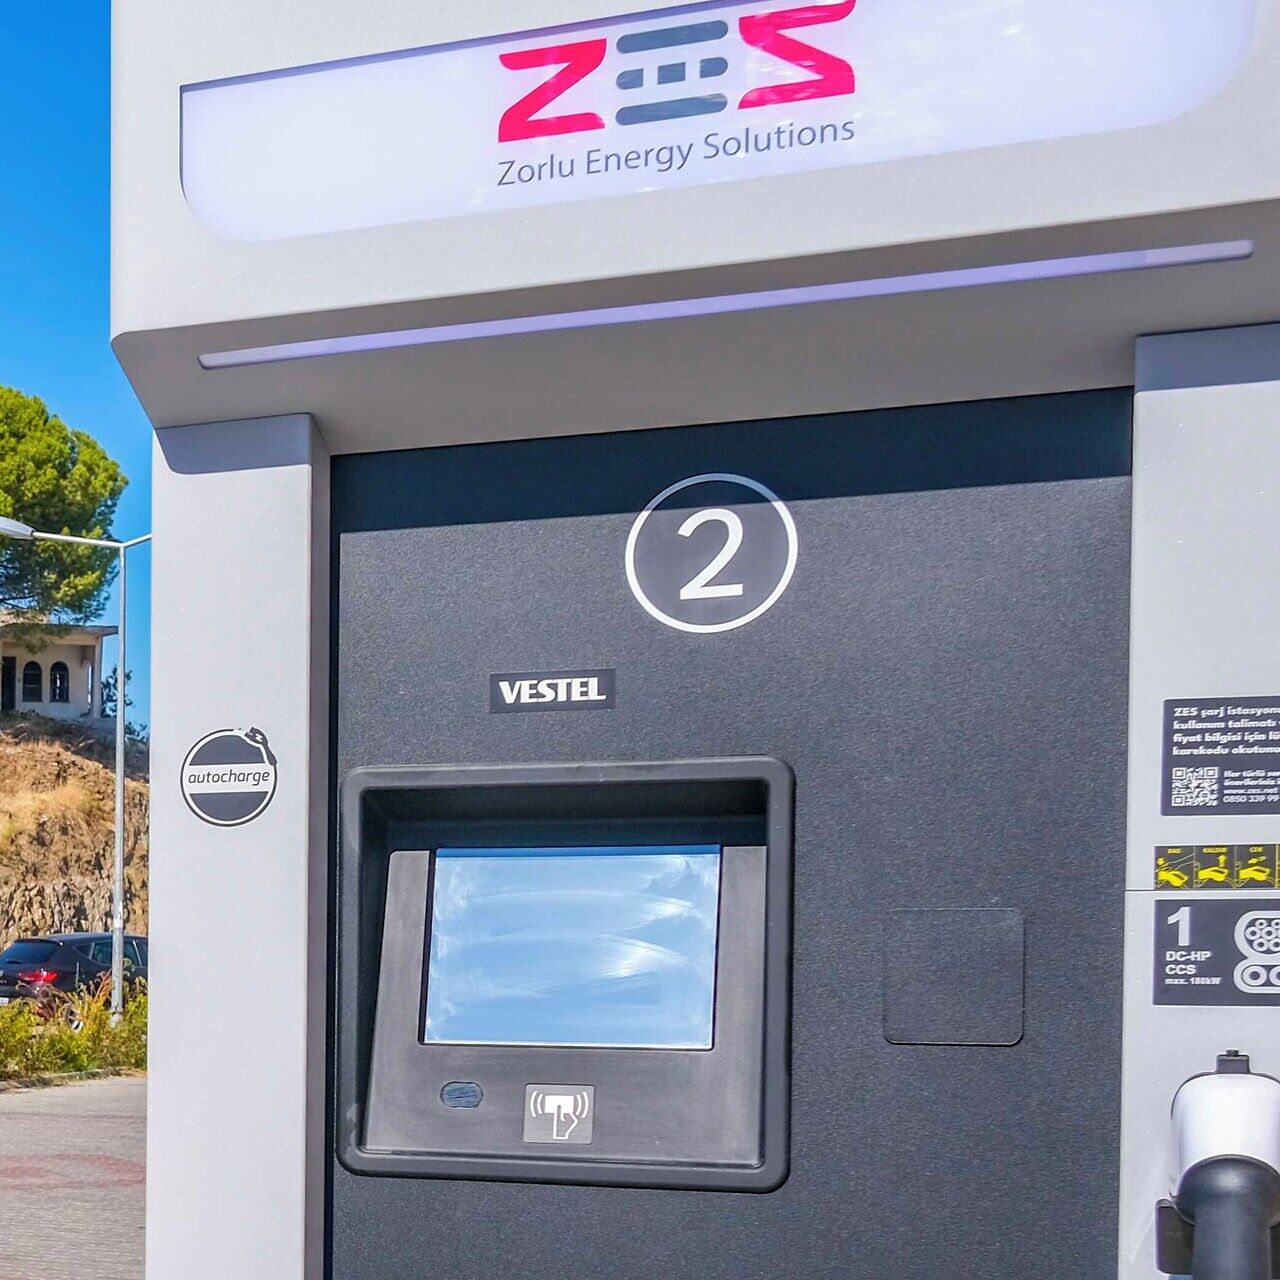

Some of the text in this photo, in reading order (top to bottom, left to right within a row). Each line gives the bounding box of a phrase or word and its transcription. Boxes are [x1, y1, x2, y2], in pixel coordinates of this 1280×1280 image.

[498, 0, 856, 143] ZES
[496, 119, 856, 186] Zorlu Energy Solutions
[677, 508, 744, 600] 2
[498, 676, 608, 704] VESTEL
[1174, 707, 1199, 717] ZES
[1173, 733, 1202, 744] fiyat
[1204, 732, 1242, 744] bilgisi
[1173, 746, 1229, 755] karekodu
[187, 767, 271, 786] autocharge
[1223, 795, 1247, 804] 0850
[1248, 795, 1265, 803] 339
[1167, 906, 1191, 947] 1
[1165, 950, 1212, 962] DC-HP
[1165, 964, 1197, 975] CCS
